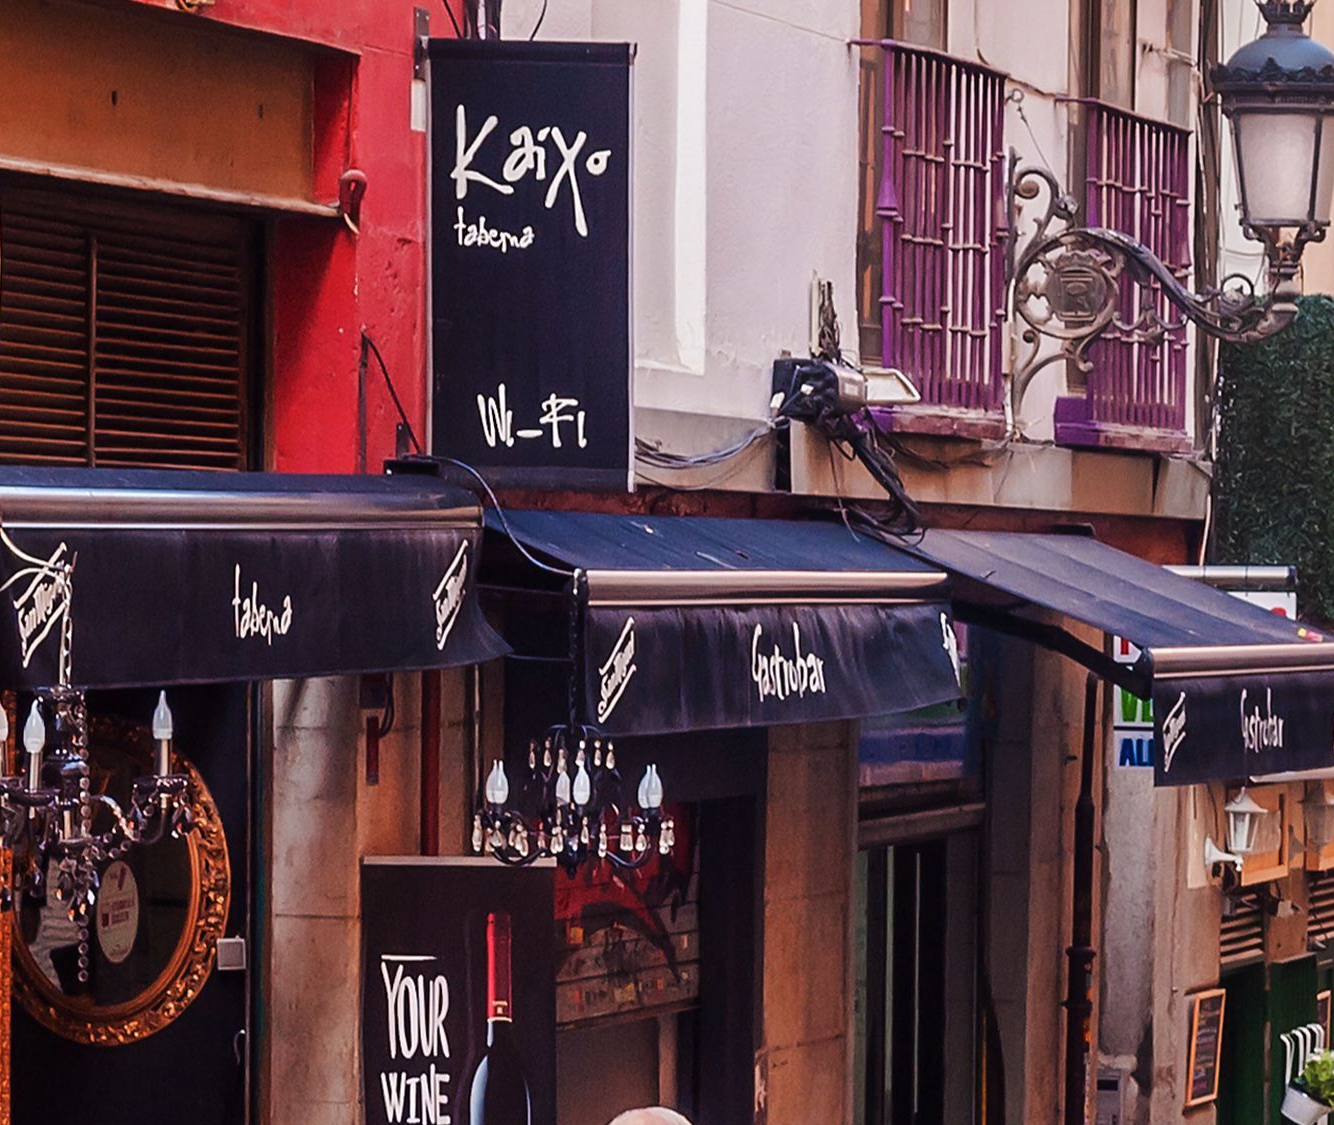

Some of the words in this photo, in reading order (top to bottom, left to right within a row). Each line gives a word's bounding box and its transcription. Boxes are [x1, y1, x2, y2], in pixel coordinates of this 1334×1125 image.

[451, 104, 611, 237] Kaixo
[454, 206, 535, 253] taberna
[232, 564, 293, 646] taberna
[751, 622, 827, 702] Gastrobar
[380, 961, 451, 1060] YOUR
